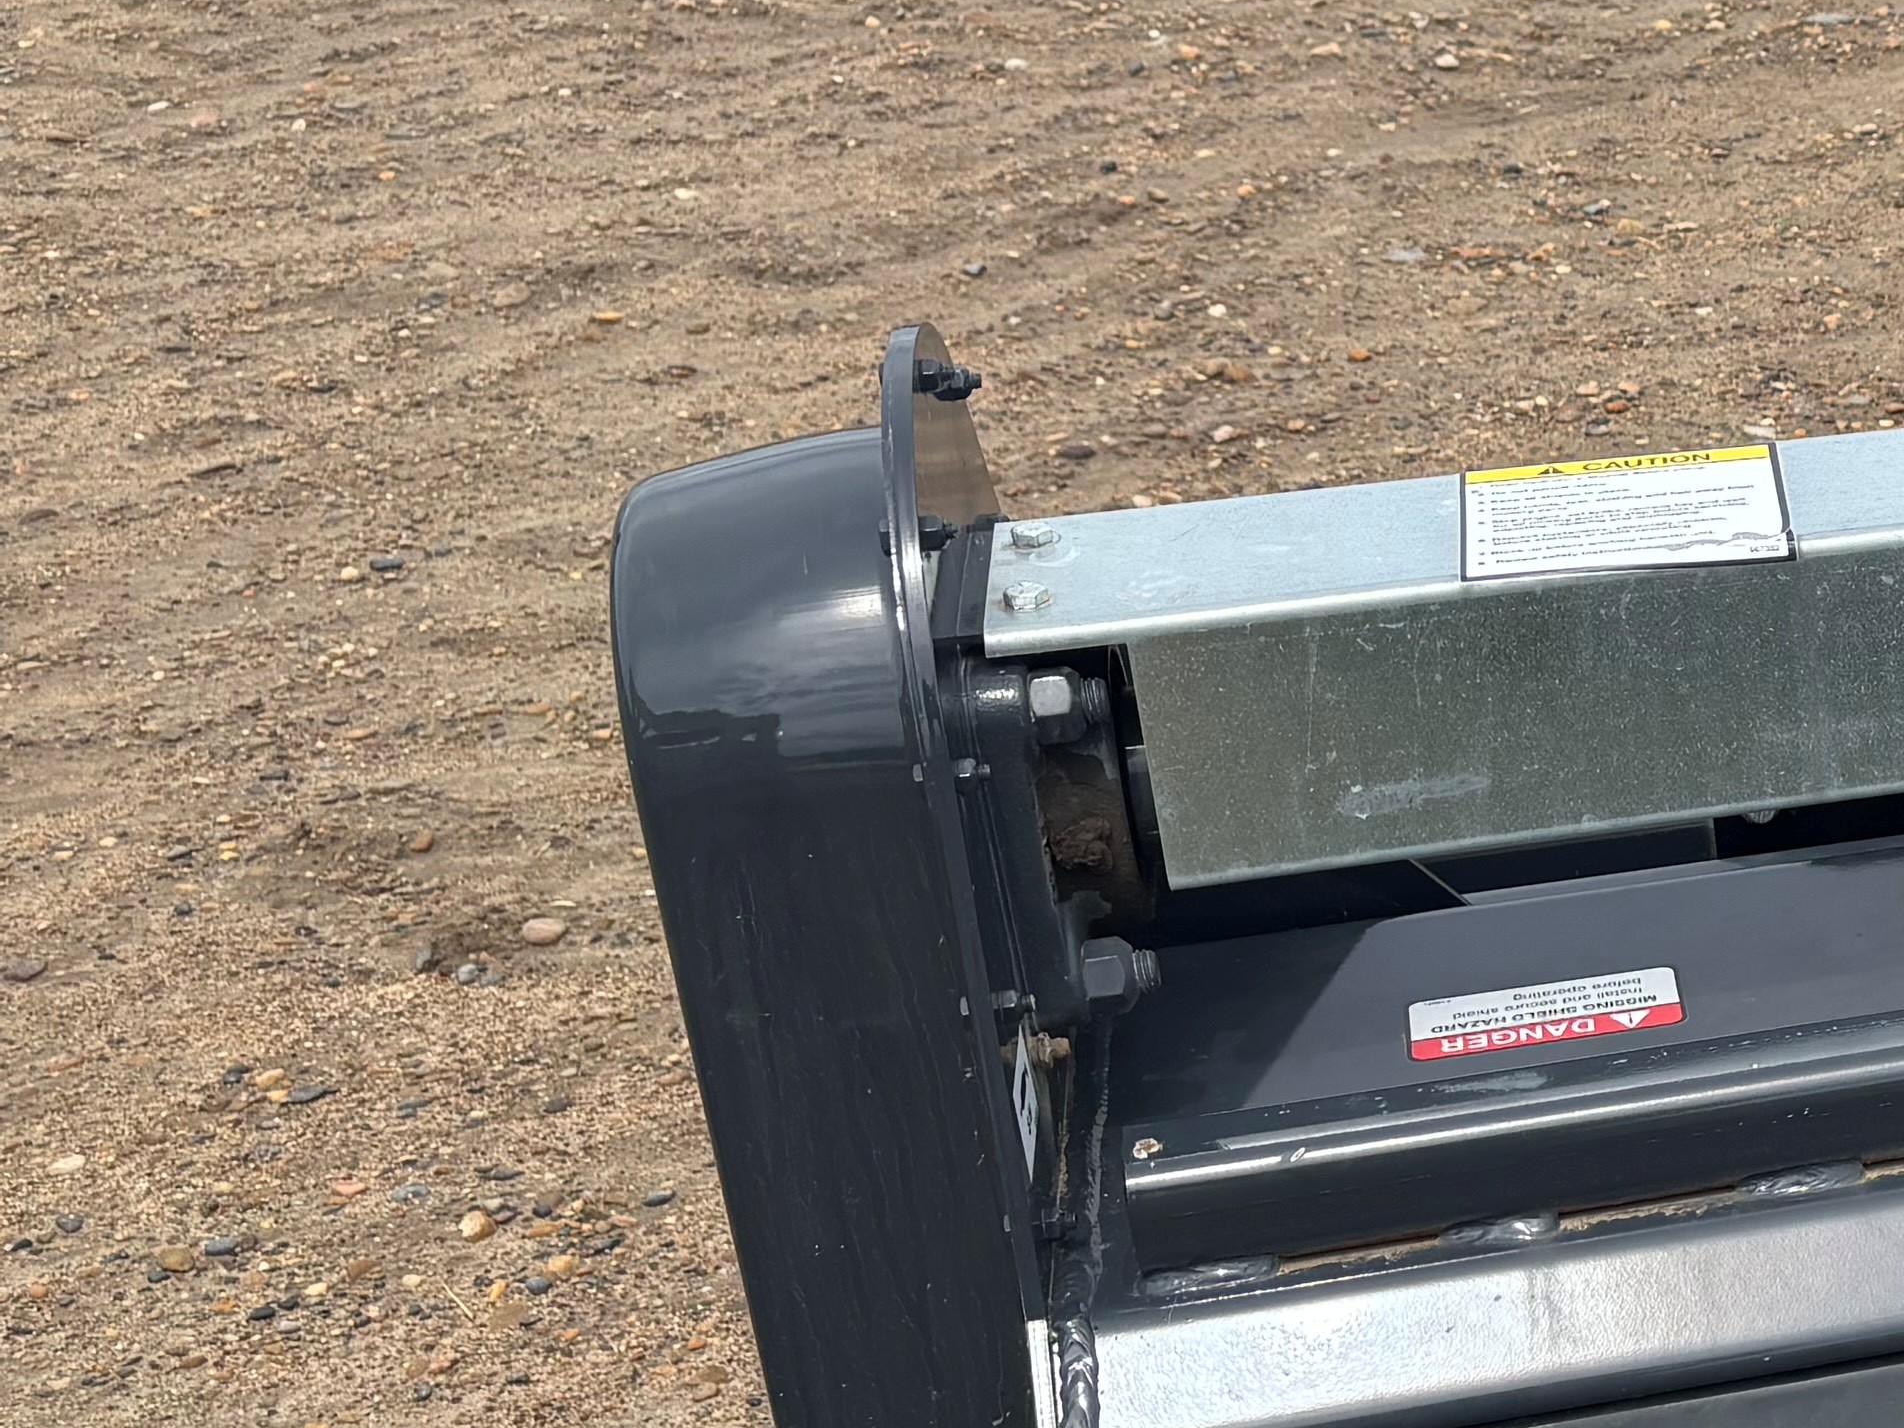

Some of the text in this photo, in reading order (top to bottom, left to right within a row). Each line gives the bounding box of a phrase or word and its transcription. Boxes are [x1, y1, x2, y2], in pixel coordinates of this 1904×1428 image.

[1582, 452, 1711, 471] CAUTION
[1591, 977, 1641, 989] before
[1562, 993, 1591, 1004] and
[1596, 986, 1642, 999] Install
[1441, 1018, 1596, 1054] DANGER
